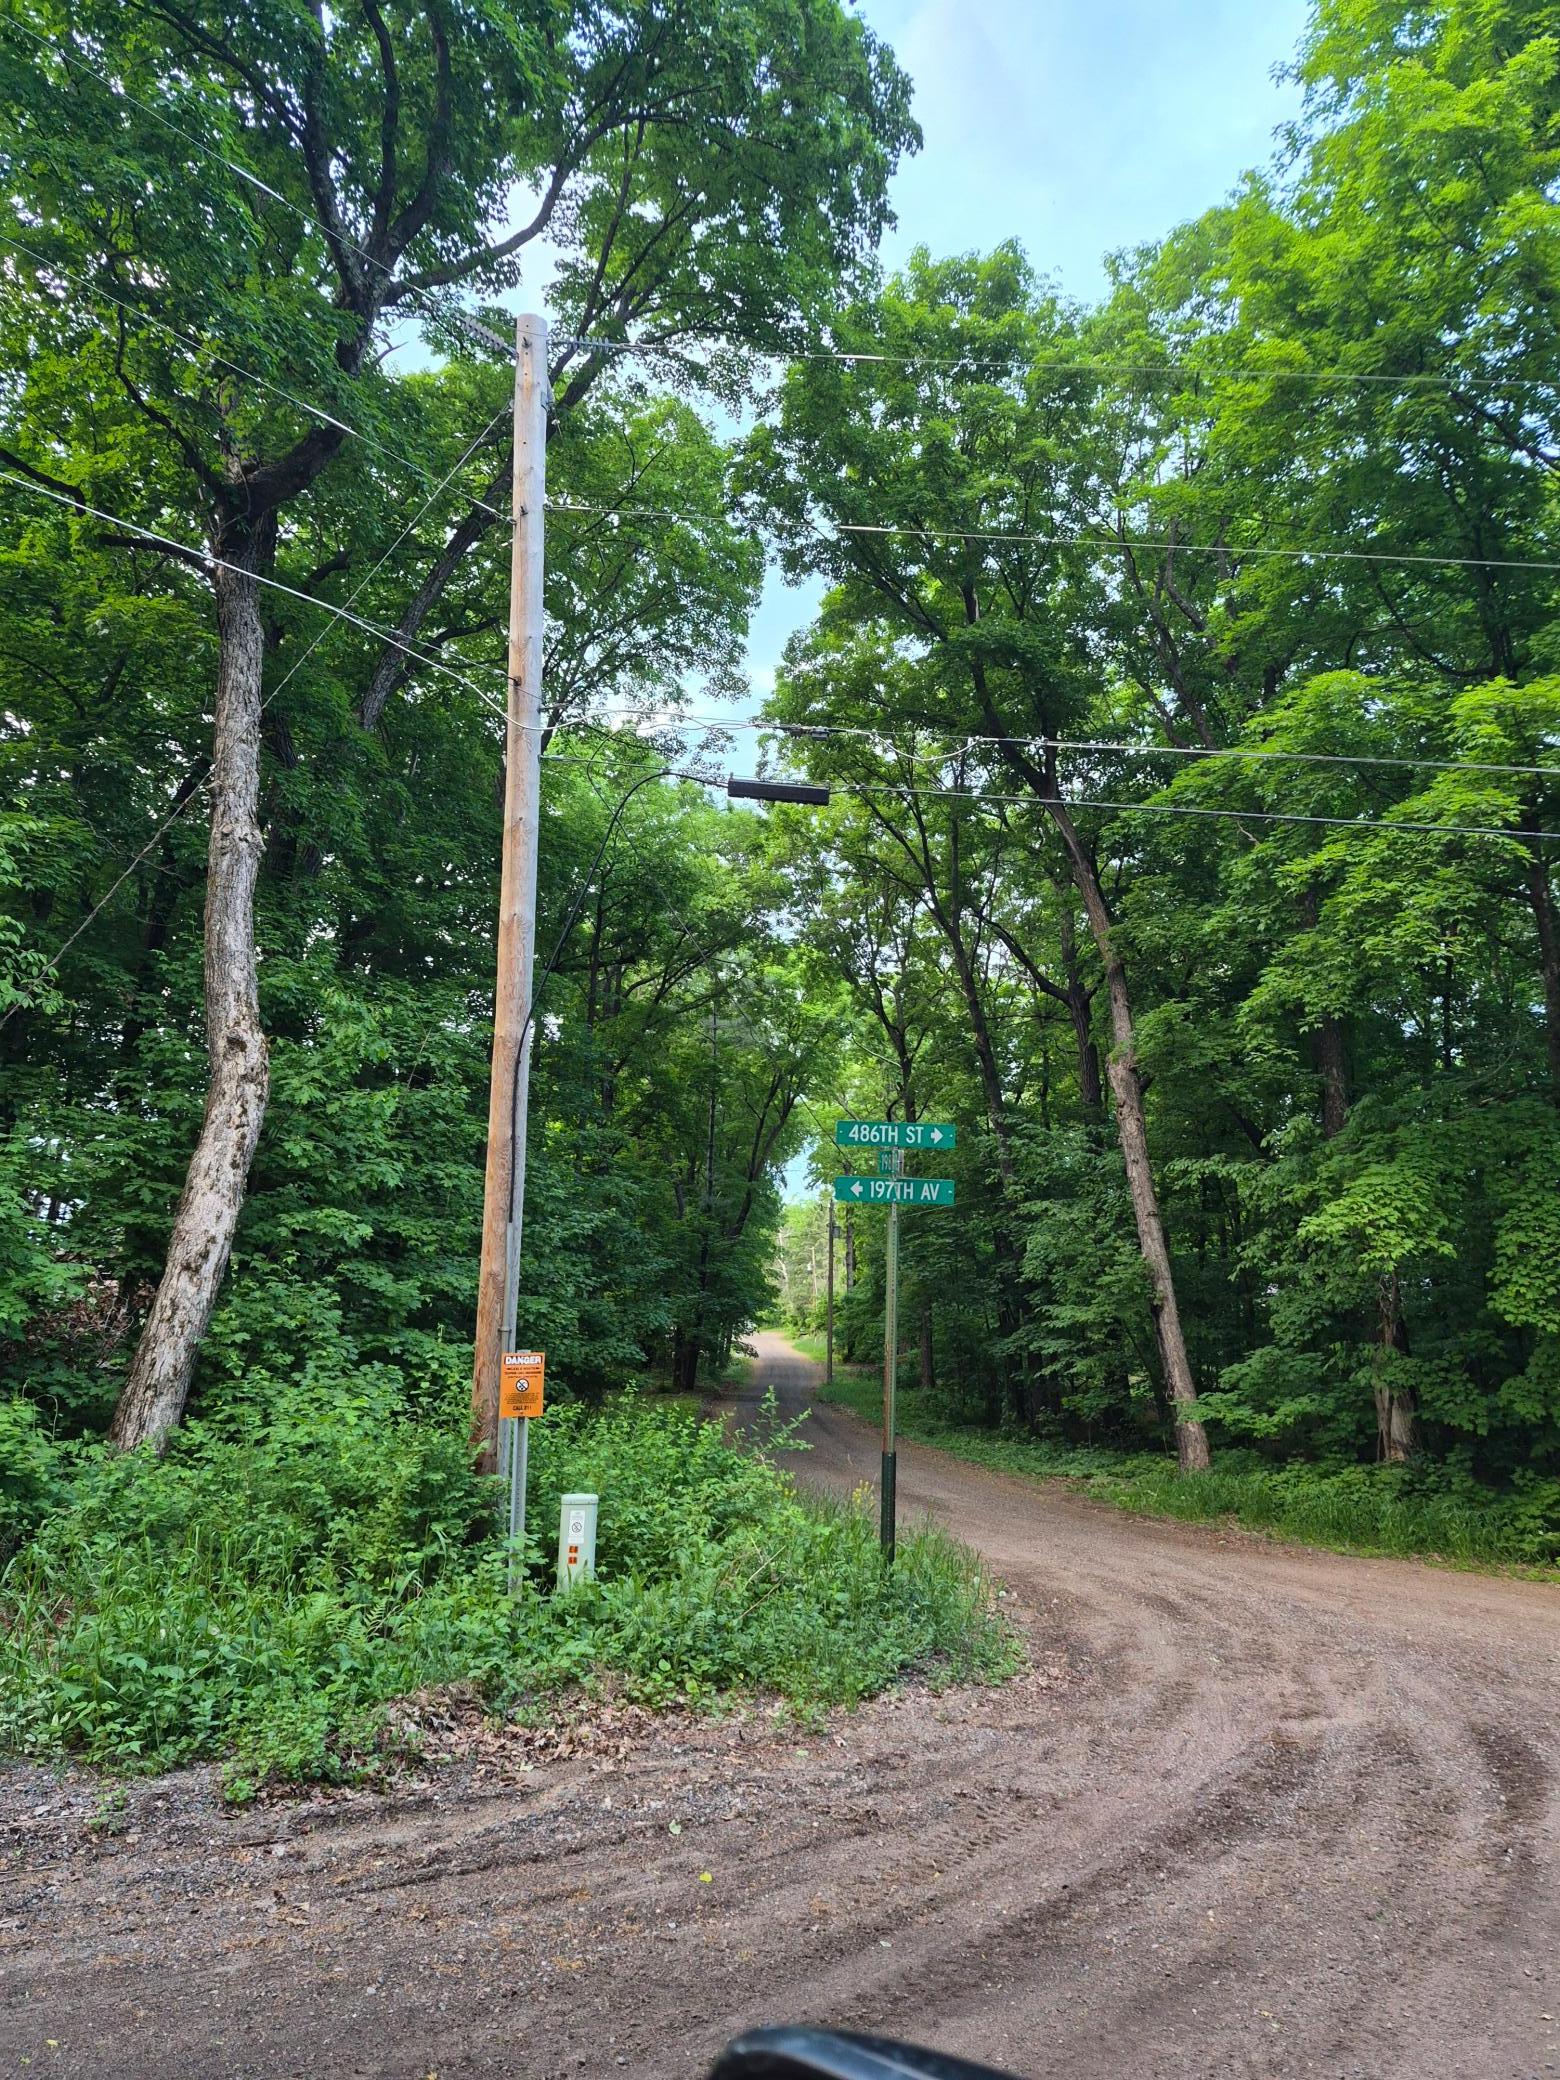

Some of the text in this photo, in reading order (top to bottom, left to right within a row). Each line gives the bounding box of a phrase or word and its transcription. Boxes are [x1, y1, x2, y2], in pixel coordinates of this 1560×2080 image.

[848, 1124, 925, 1144] 486TH ST
[870, 1180, 940, 1201] 197TH AV
[505, 1356, 541, 1365] DANGER
